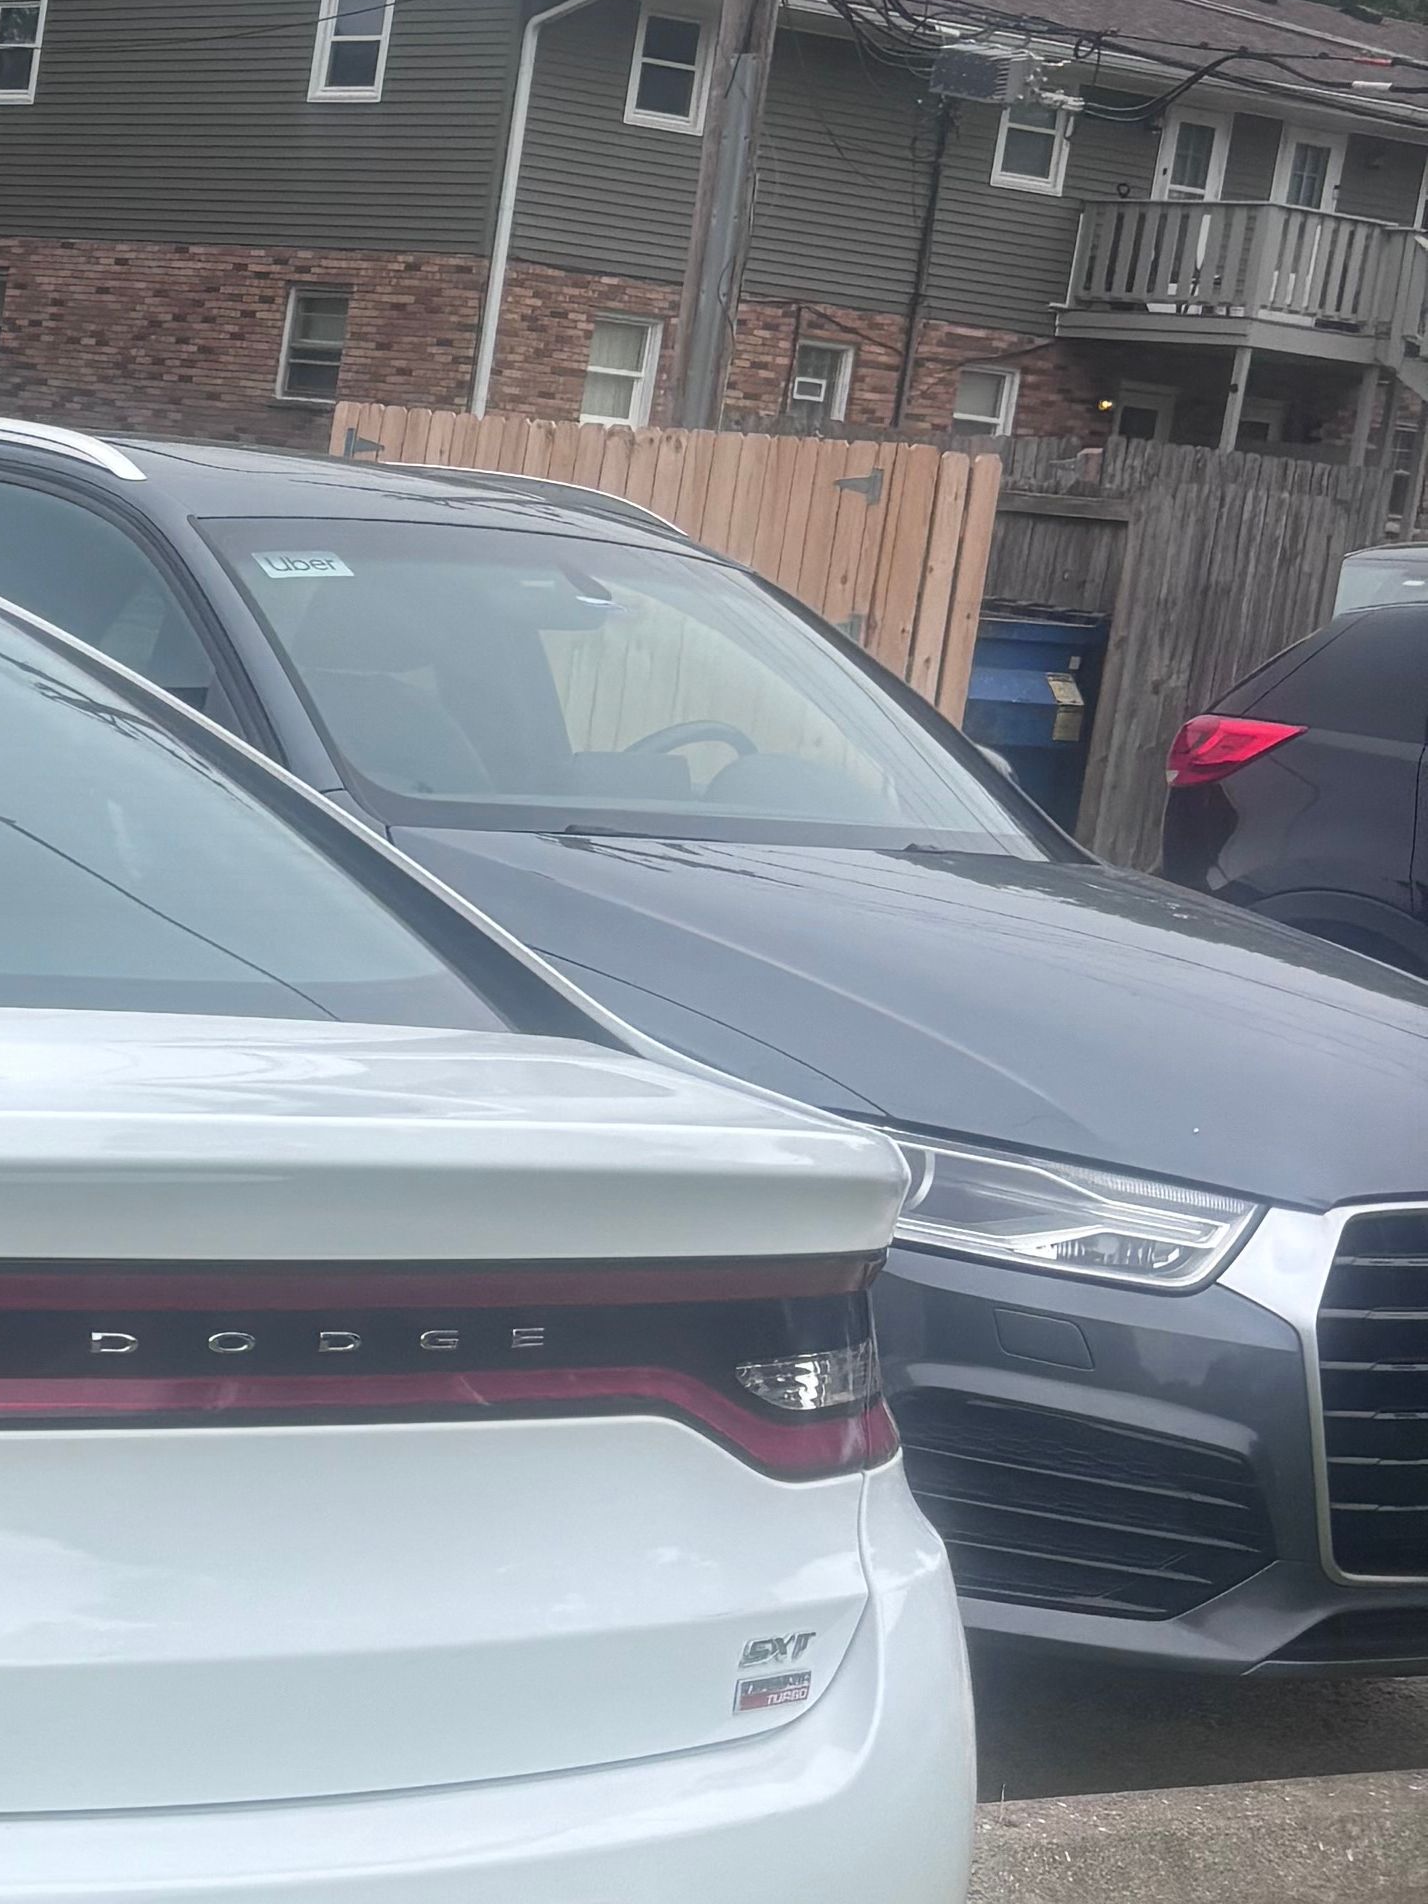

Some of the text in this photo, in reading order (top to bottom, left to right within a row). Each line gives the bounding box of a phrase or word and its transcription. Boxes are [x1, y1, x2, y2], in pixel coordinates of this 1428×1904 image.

[264, 556, 338, 572] Uber
[90, 1327, 545, 1354] DODGE
[738, 1632, 817, 1669] SXT
[766, 1687, 809, 1705] TURBO
